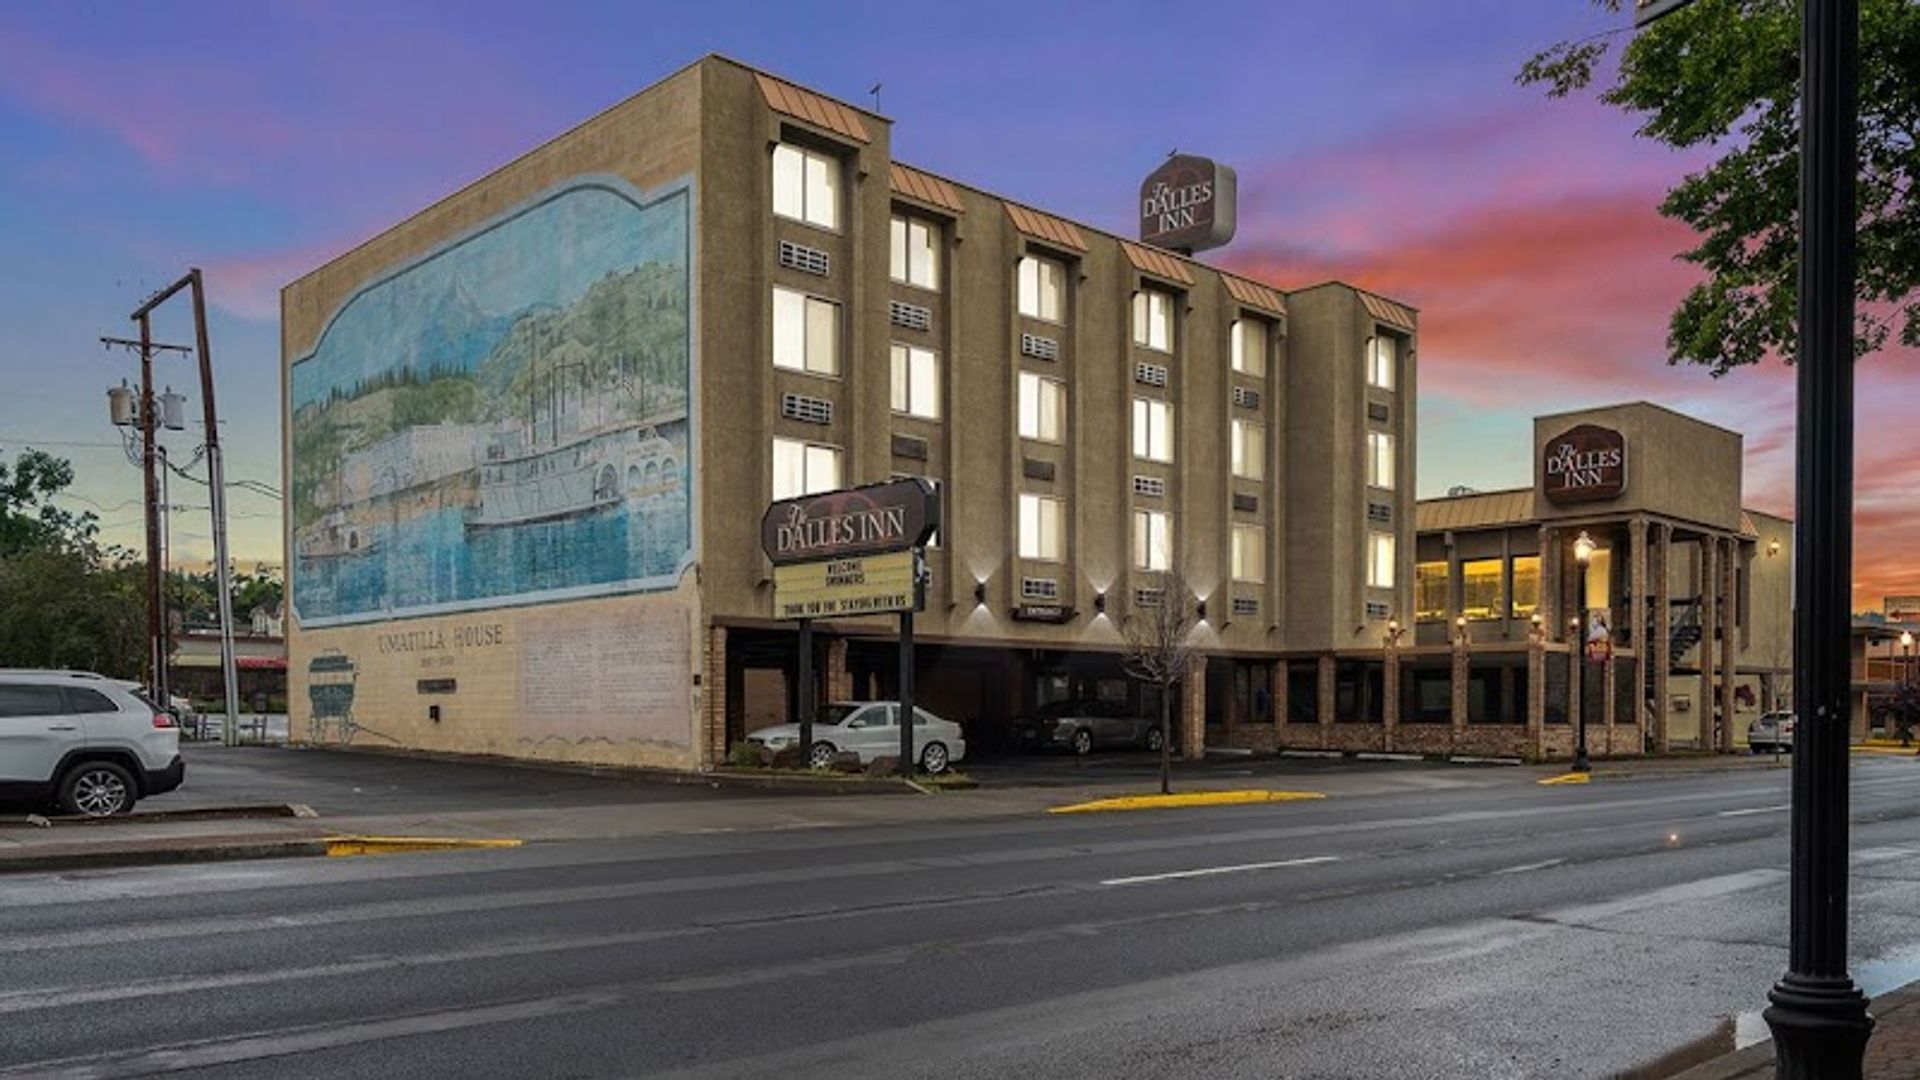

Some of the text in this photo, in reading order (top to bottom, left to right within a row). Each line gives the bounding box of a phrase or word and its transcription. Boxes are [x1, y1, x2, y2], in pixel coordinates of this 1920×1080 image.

[1144, 181, 1212, 217] DALLES
[1158, 207, 1195, 233] INN
[1547, 449, 1621, 473] DALLES
[1564, 469, 1602, 488] INN
[777, 509, 906, 551] DALLES INN
[378, 624, 503, 653] UMATILLA HOUSE
